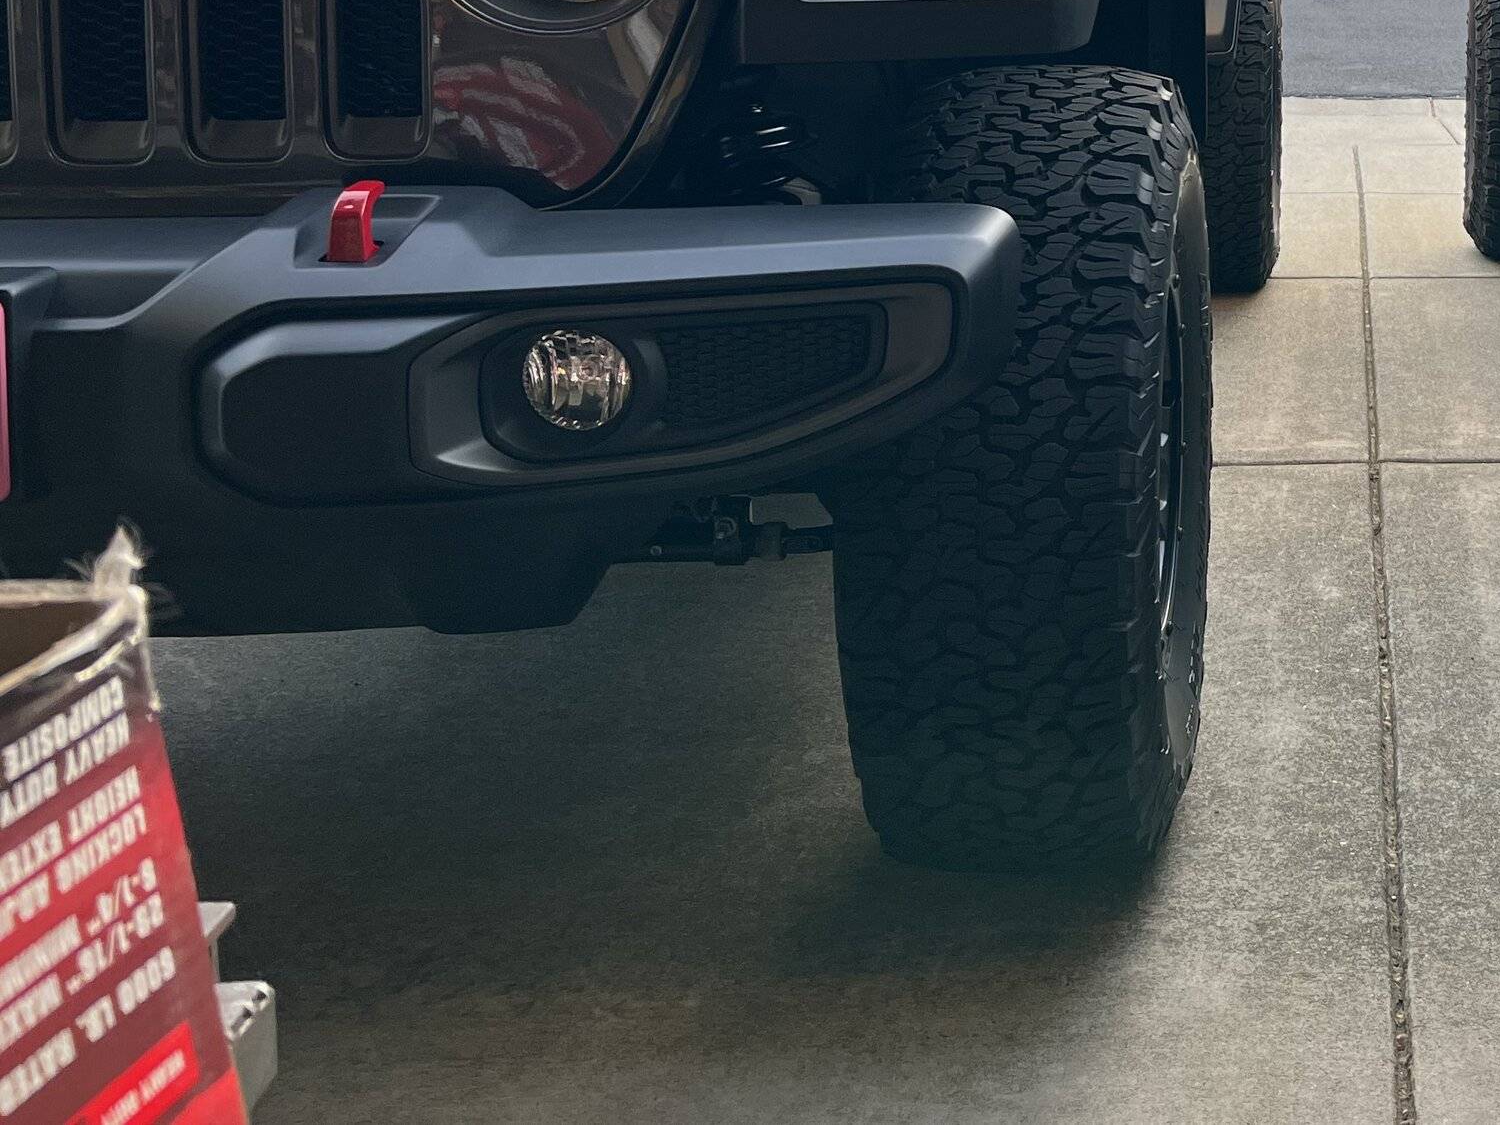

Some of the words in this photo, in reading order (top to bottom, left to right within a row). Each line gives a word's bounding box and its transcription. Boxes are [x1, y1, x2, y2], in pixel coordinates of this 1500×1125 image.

[2, 675, 125, 783] COMPOSITE
[64, 711, 130, 785] HEAVY
[0, 759, 59, 828] DUTY
[68, 765, 141, 842] HEIGHT
[54, 803, 147, 894] LOCKING
[115, 945, 177, 1015] 6000
